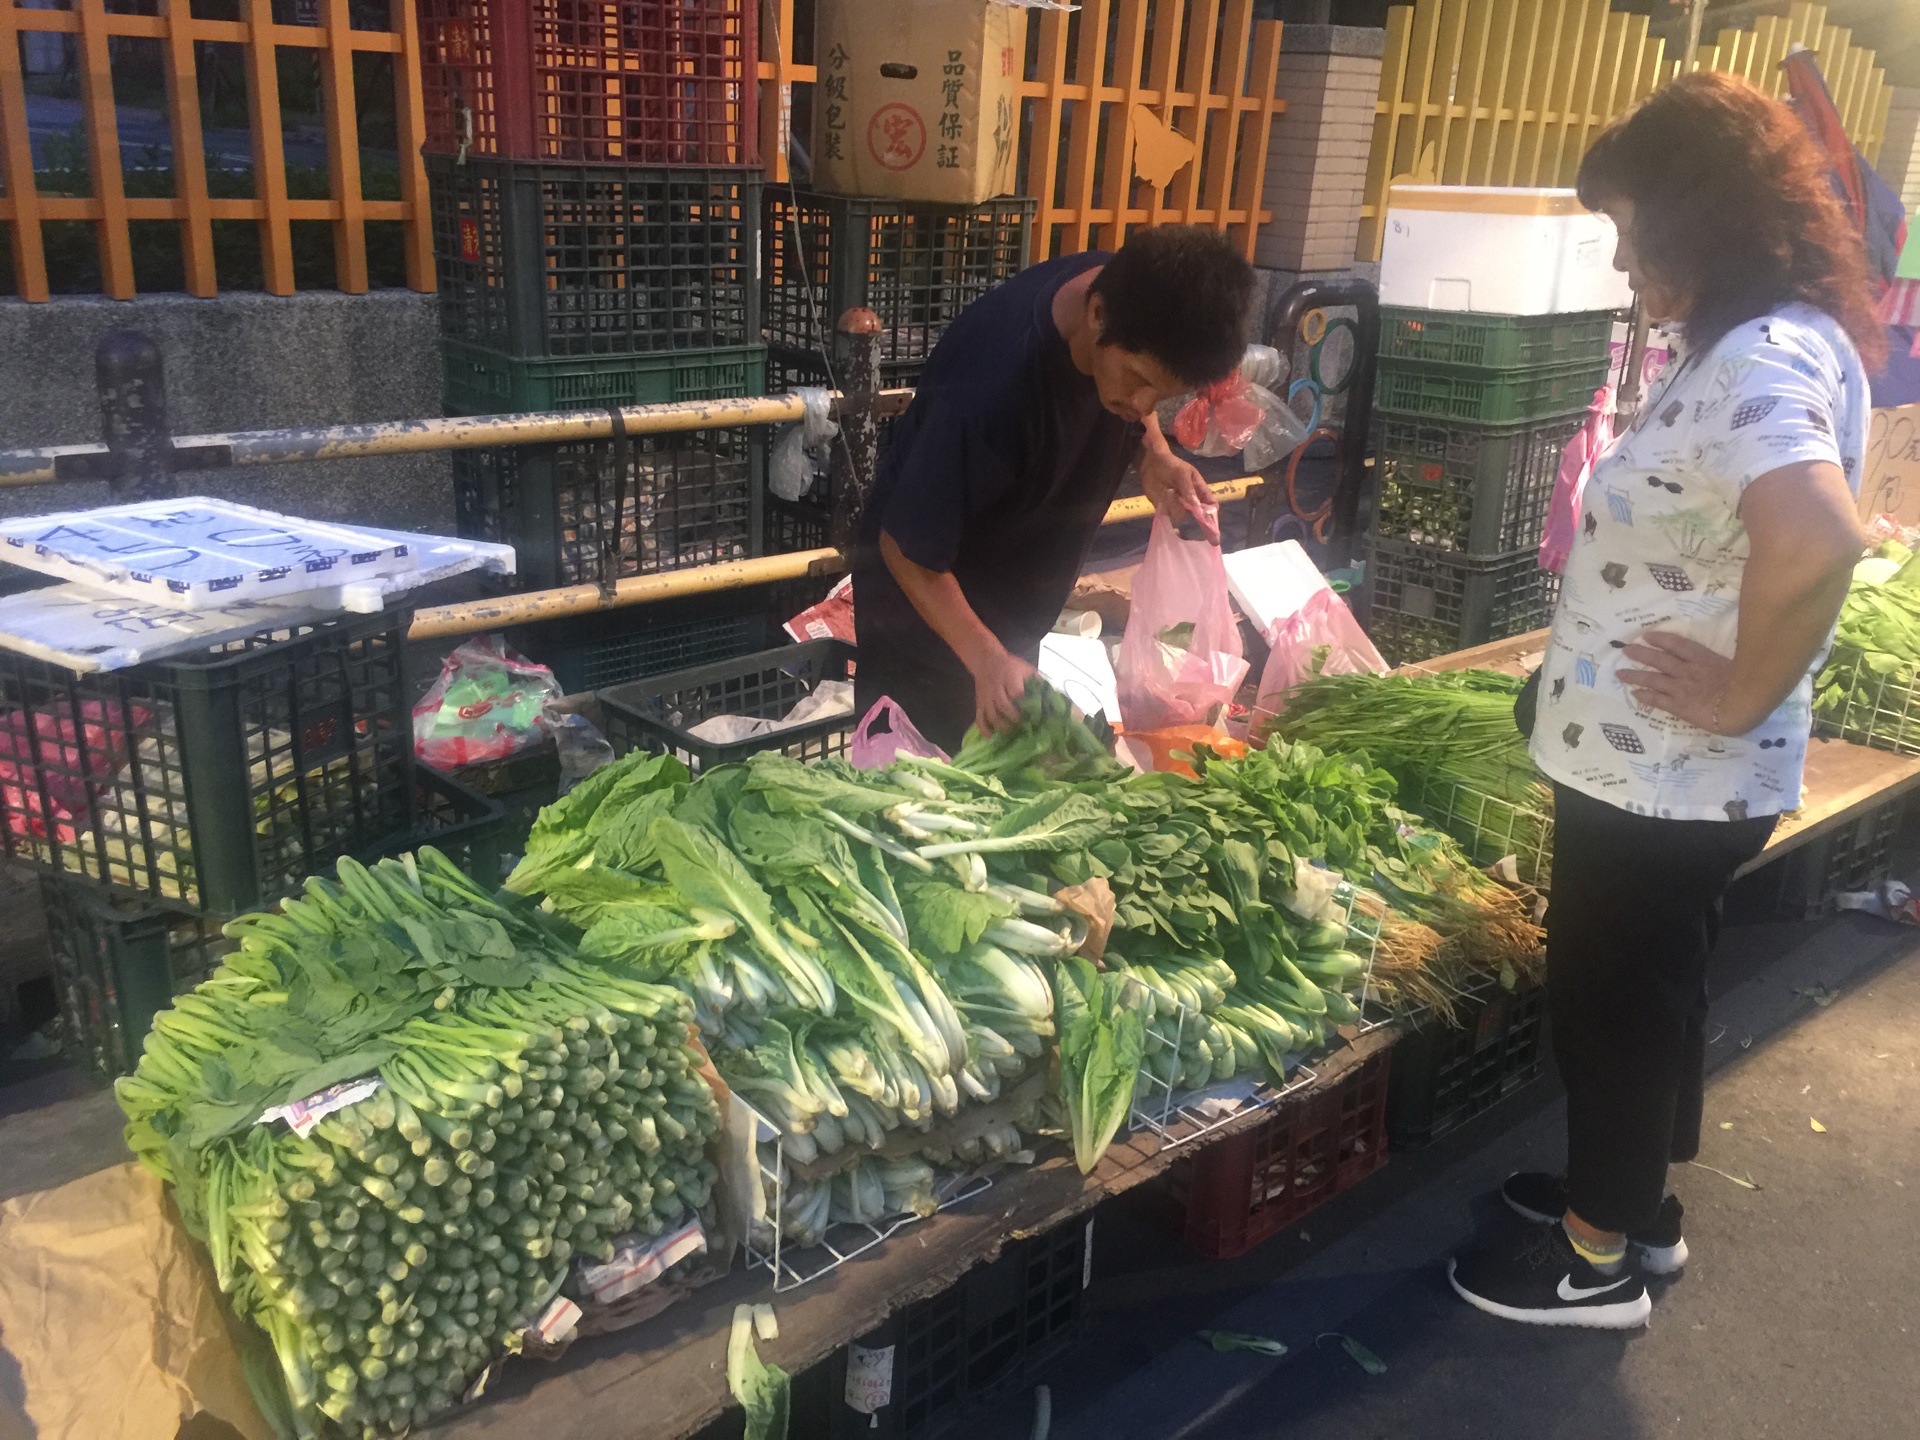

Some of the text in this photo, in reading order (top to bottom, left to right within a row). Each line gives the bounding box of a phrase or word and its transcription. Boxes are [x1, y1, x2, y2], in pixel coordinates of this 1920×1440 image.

[824, 42, 851, 161] 分級包裝
[936, 49, 966, 169] 品質保証
